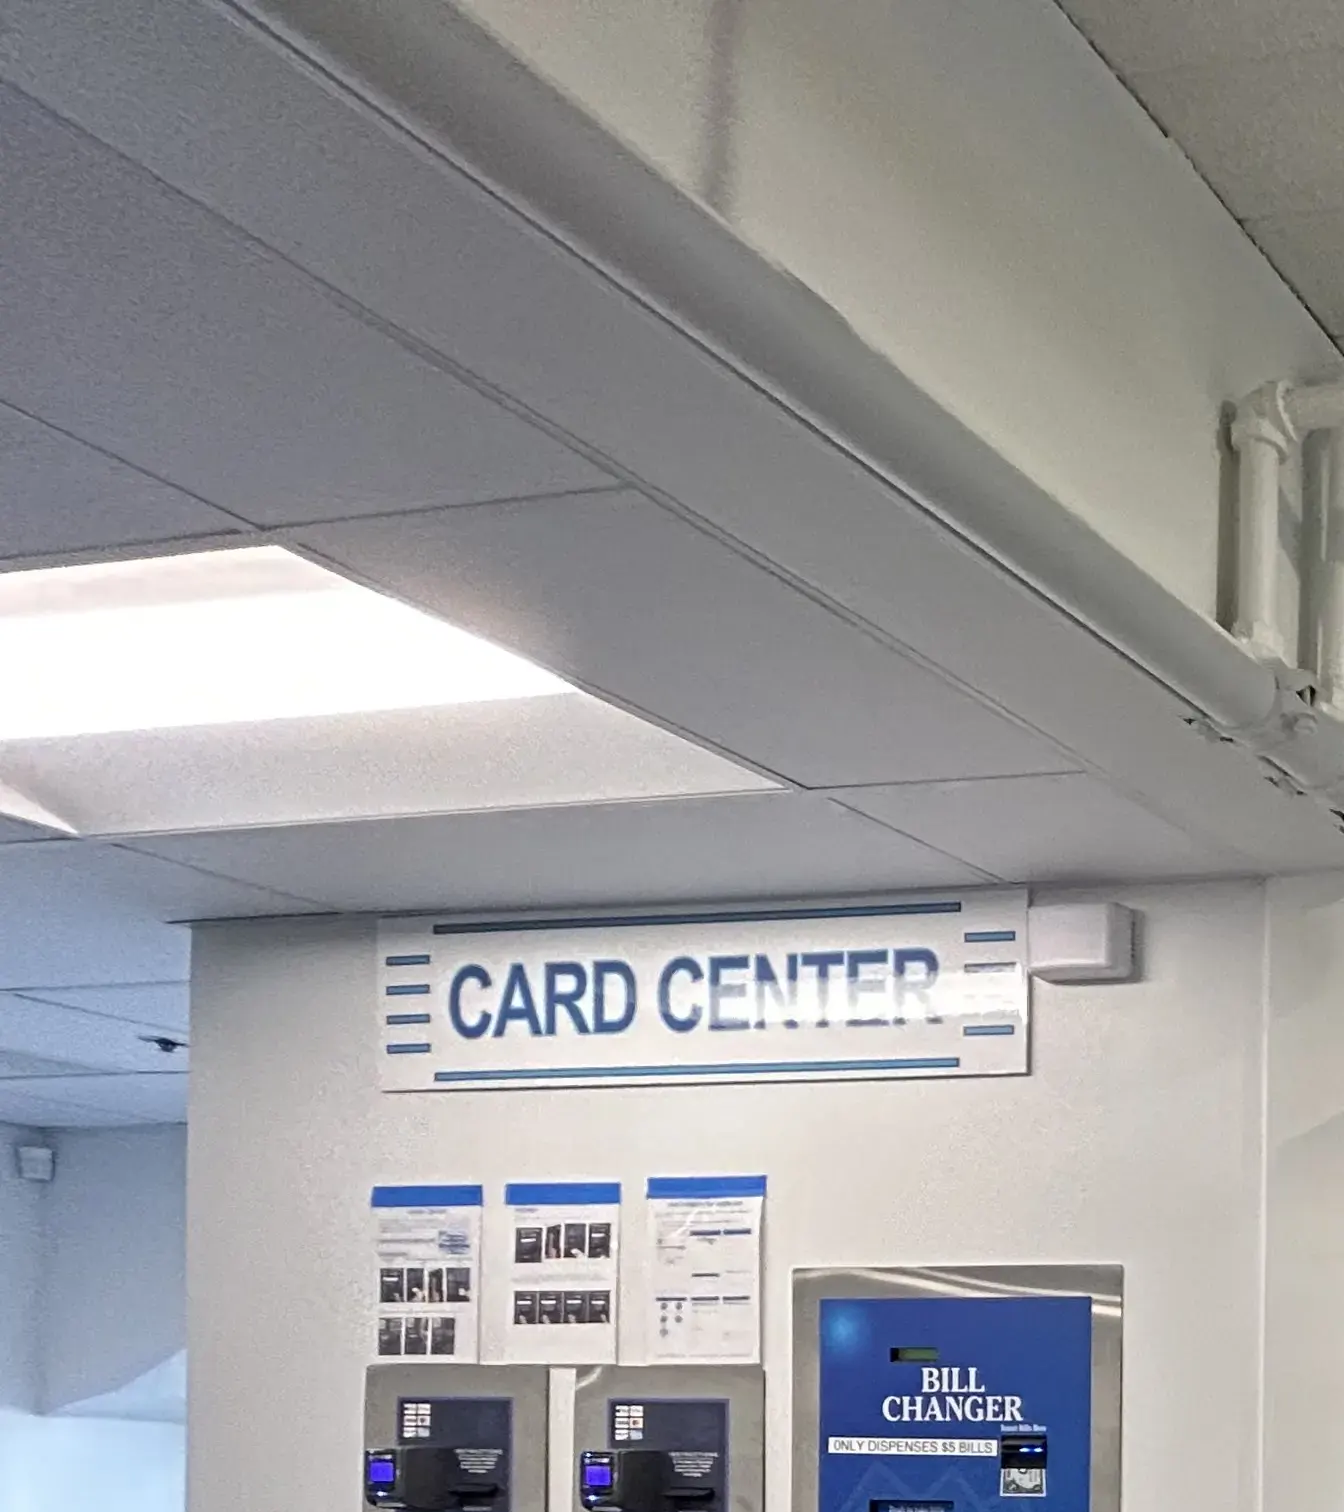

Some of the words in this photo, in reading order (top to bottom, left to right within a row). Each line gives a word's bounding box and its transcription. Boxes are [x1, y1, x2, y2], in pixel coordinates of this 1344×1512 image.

[448, 958, 637, 1040] CARD
[656, 946, 944, 1033] CENTER
[921, 1366, 986, 1393] BILL
[881, 1395, 1024, 1422] CHANGER
[833, 1439, 865, 1452] ONLY
[867, 1439, 938, 1453] DISPENSES
[941, 1441, 956, 1454] $5
[958, 1441, 993, 1455] BILLS
